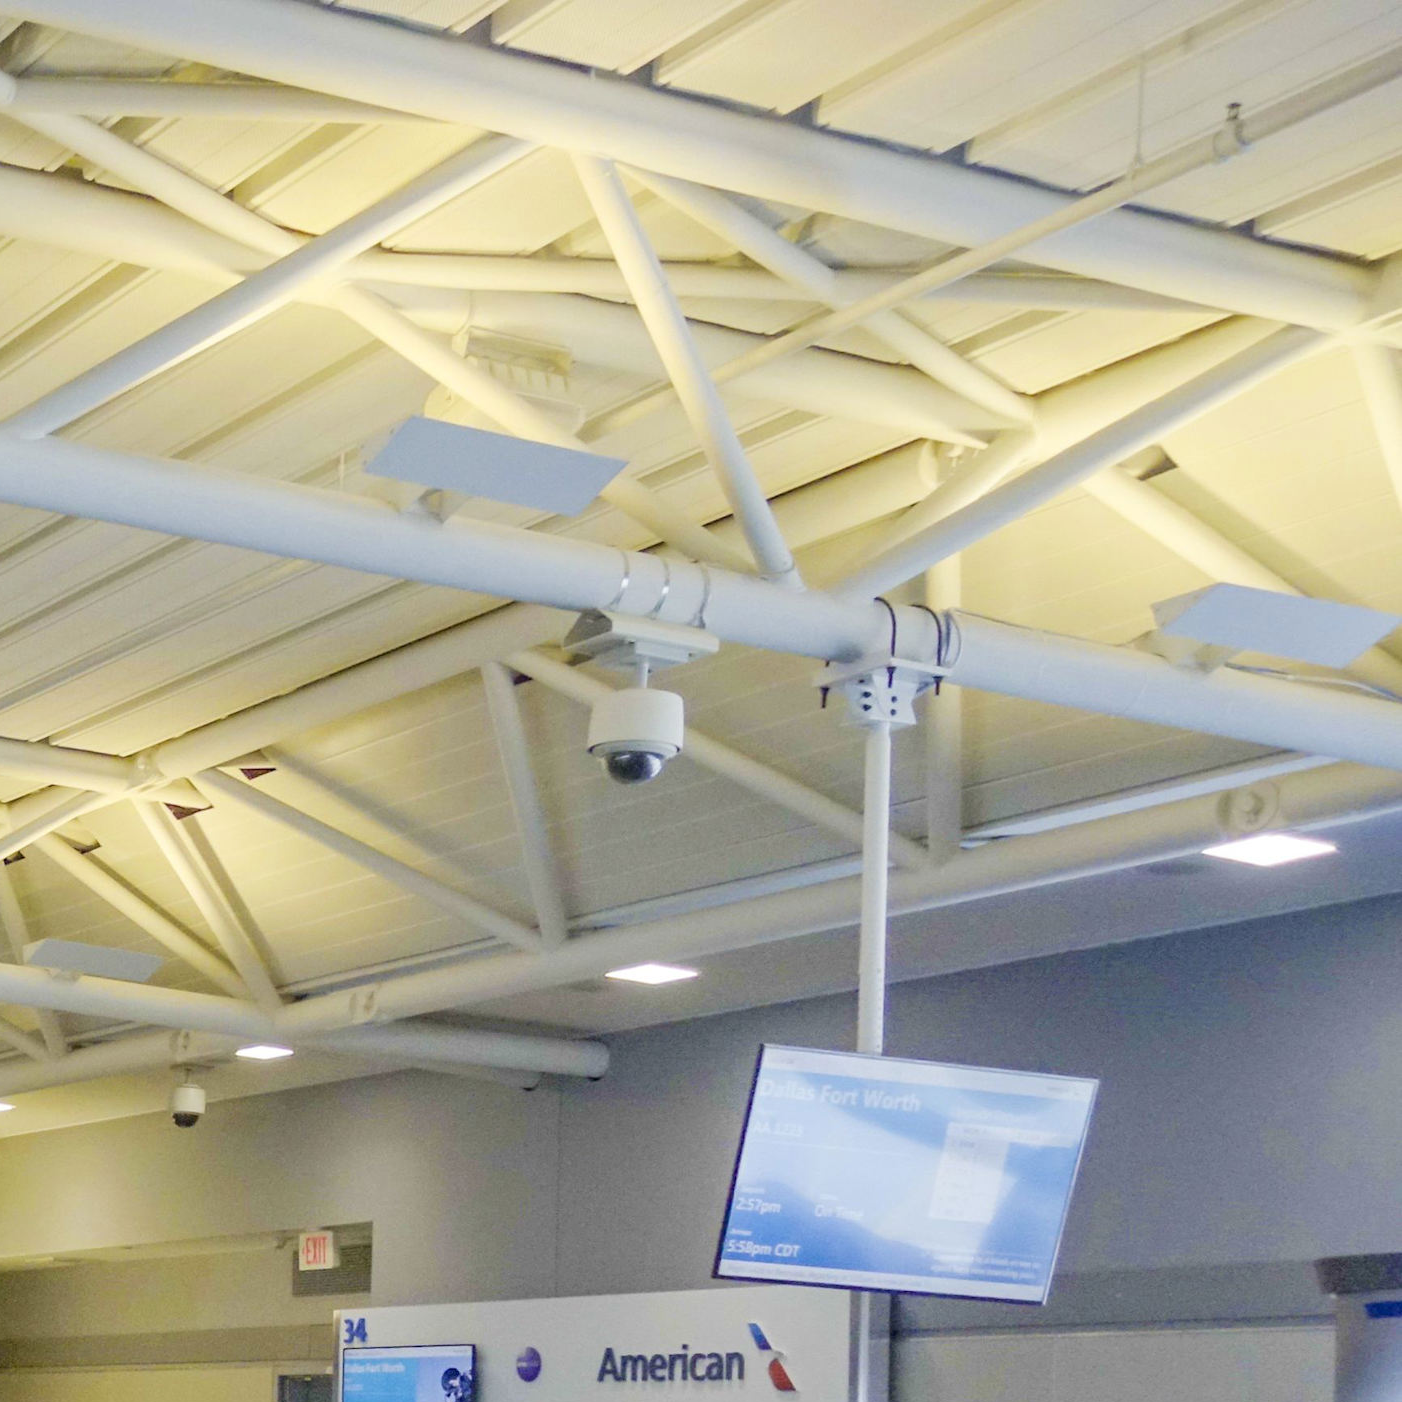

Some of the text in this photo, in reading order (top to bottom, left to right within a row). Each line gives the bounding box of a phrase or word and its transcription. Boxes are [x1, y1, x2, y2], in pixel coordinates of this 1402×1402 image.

[759, 1079, 922, 1113] Dallas Fort Worth
[735, 1197, 782, 1215] 2:57pm
[814, 1203, 832, 1218] On
[306, 1236, 328, 1265] EXIT
[726, 1239, 801, 1258] 5:58pm CDT
[343, 1318, 368, 1344] 34
[597, 1343, 745, 1382] American
